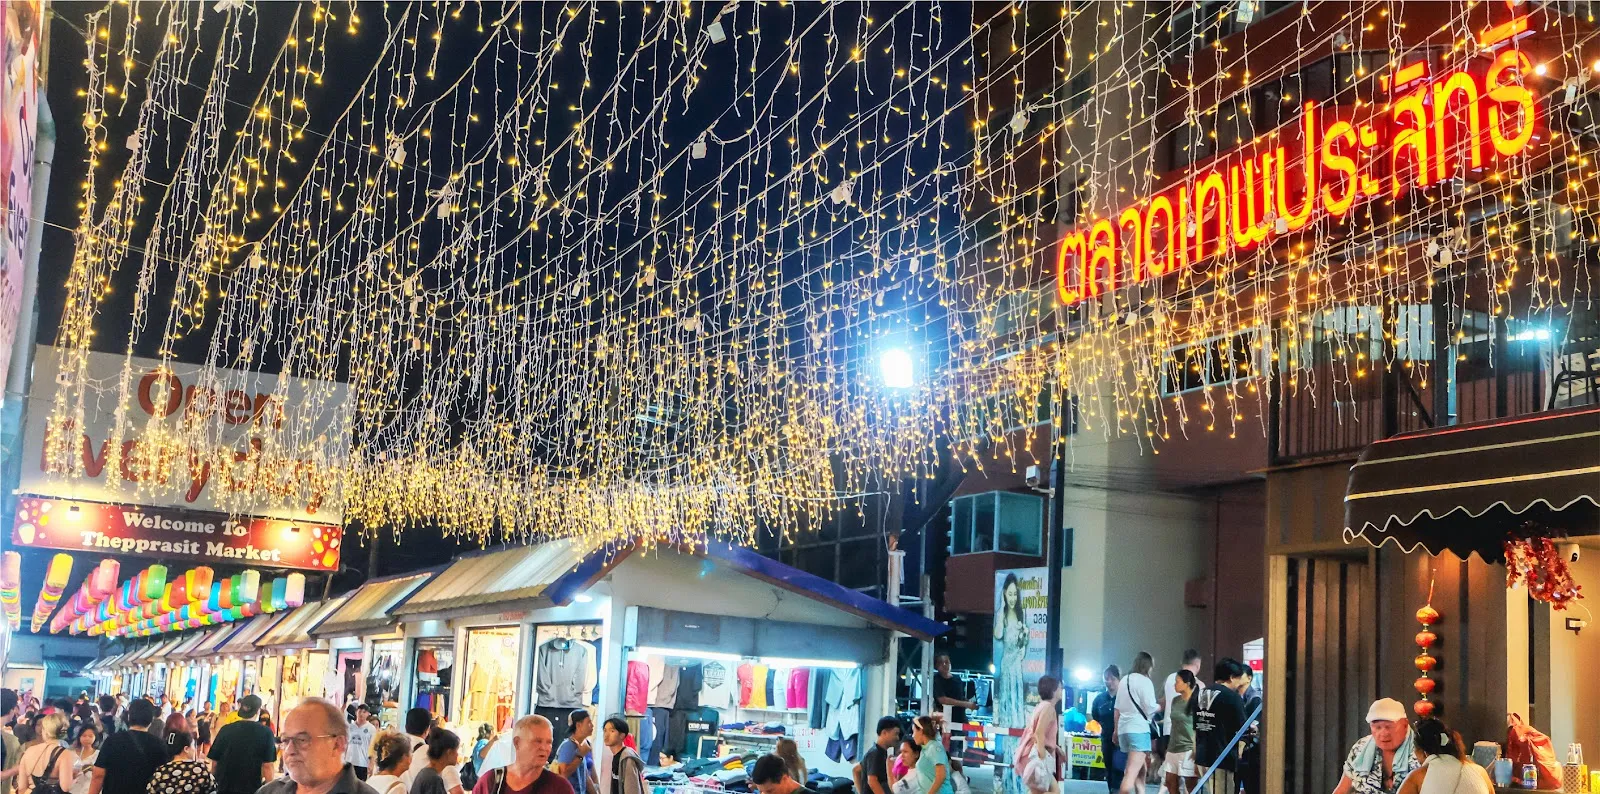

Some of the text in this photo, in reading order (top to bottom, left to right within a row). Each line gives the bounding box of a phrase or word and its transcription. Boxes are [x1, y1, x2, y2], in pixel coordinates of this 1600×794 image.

[138, 369, 284, 430] Open
[122, 511, 248, 538] Welcome To
[81, 530, 281, 562] Thepprasit Market
